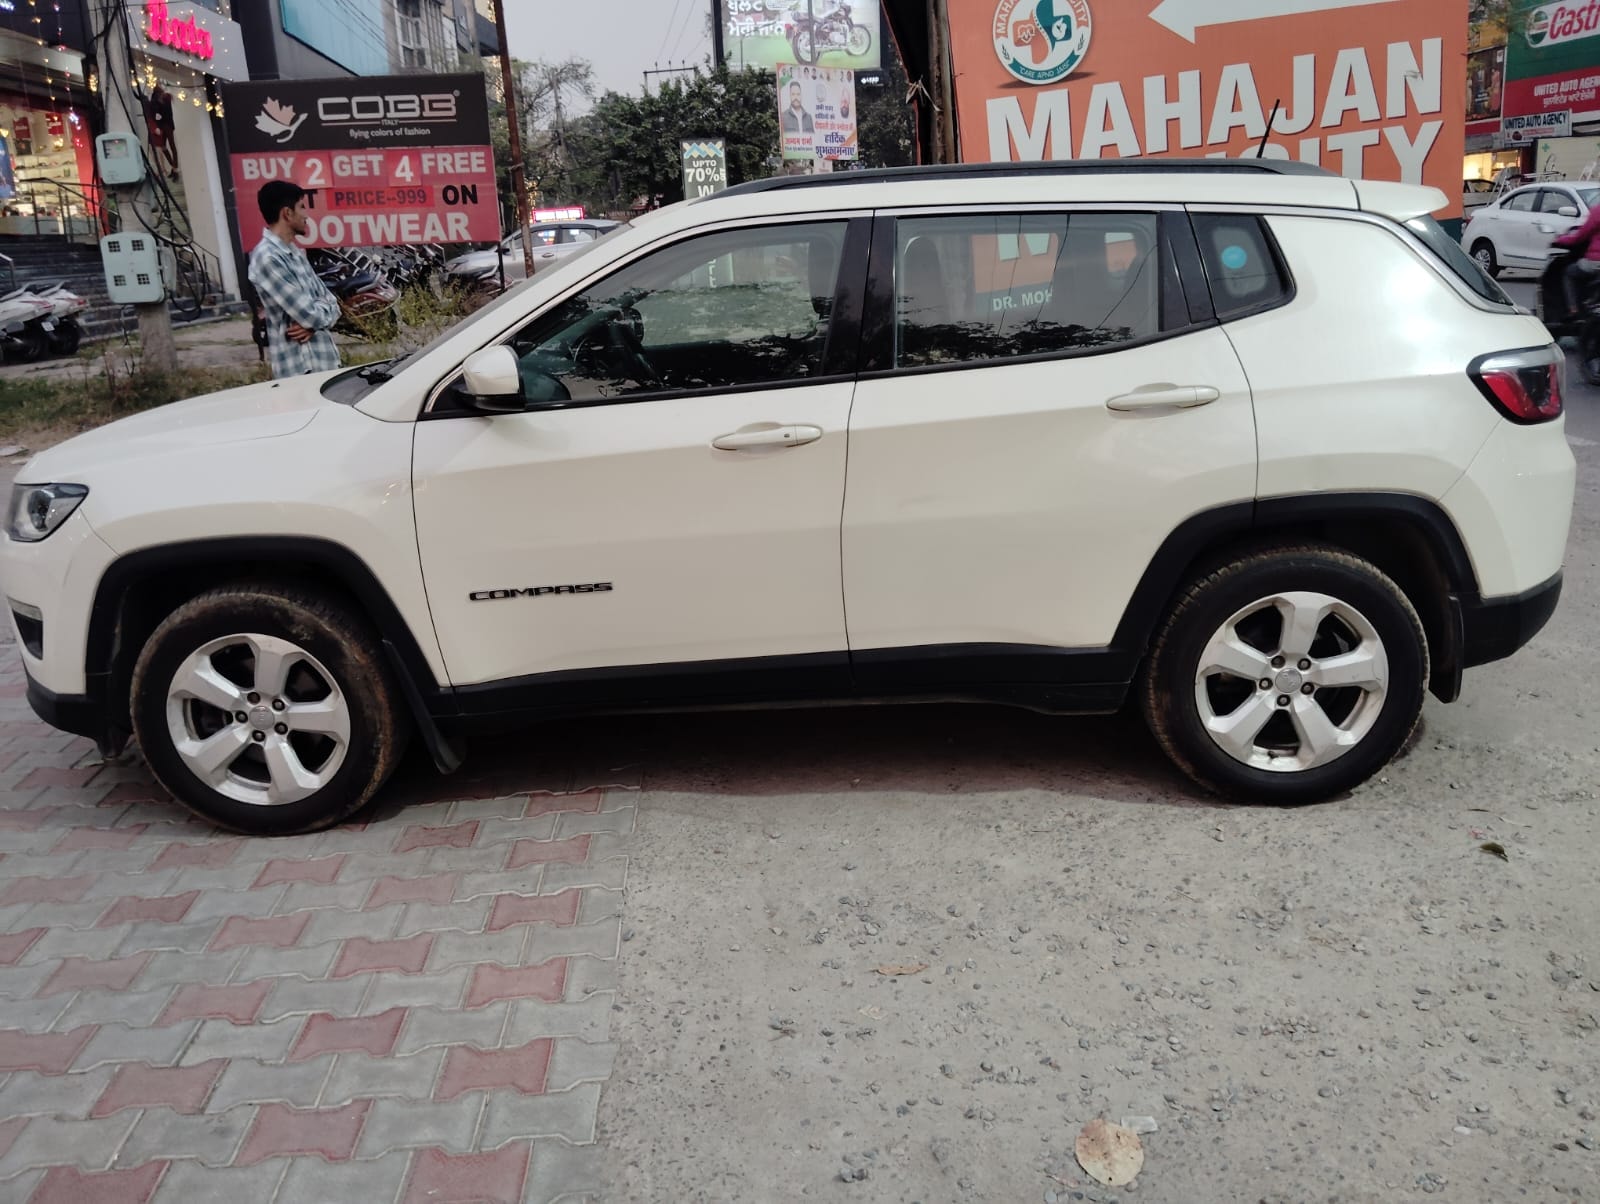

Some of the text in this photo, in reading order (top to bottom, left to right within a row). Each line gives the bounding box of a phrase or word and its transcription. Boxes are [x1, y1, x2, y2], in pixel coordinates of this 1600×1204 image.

[1534, 82, 1559, 97] UNITED
[1559, 79, 1578, 93] AUTO
[317, 93, 457, 121] COBB
[986, 37, 1443, 163] MAHAJAN
[1504, 111, 1567, 130] UNITED AUTO AGENCY
[349, 127, 431, 139] flying colors of fashion
[241, 151, 487, 186] BUY 2 GET 4 FREE
[685, 167, 720, 182] 70%
[442, 184, 479, 206] ON
[294, 212, 473, 246] OOTWEAR
[992, 295, 1017, 311] DR.
[469, 582, 613, 601] COMPASS
